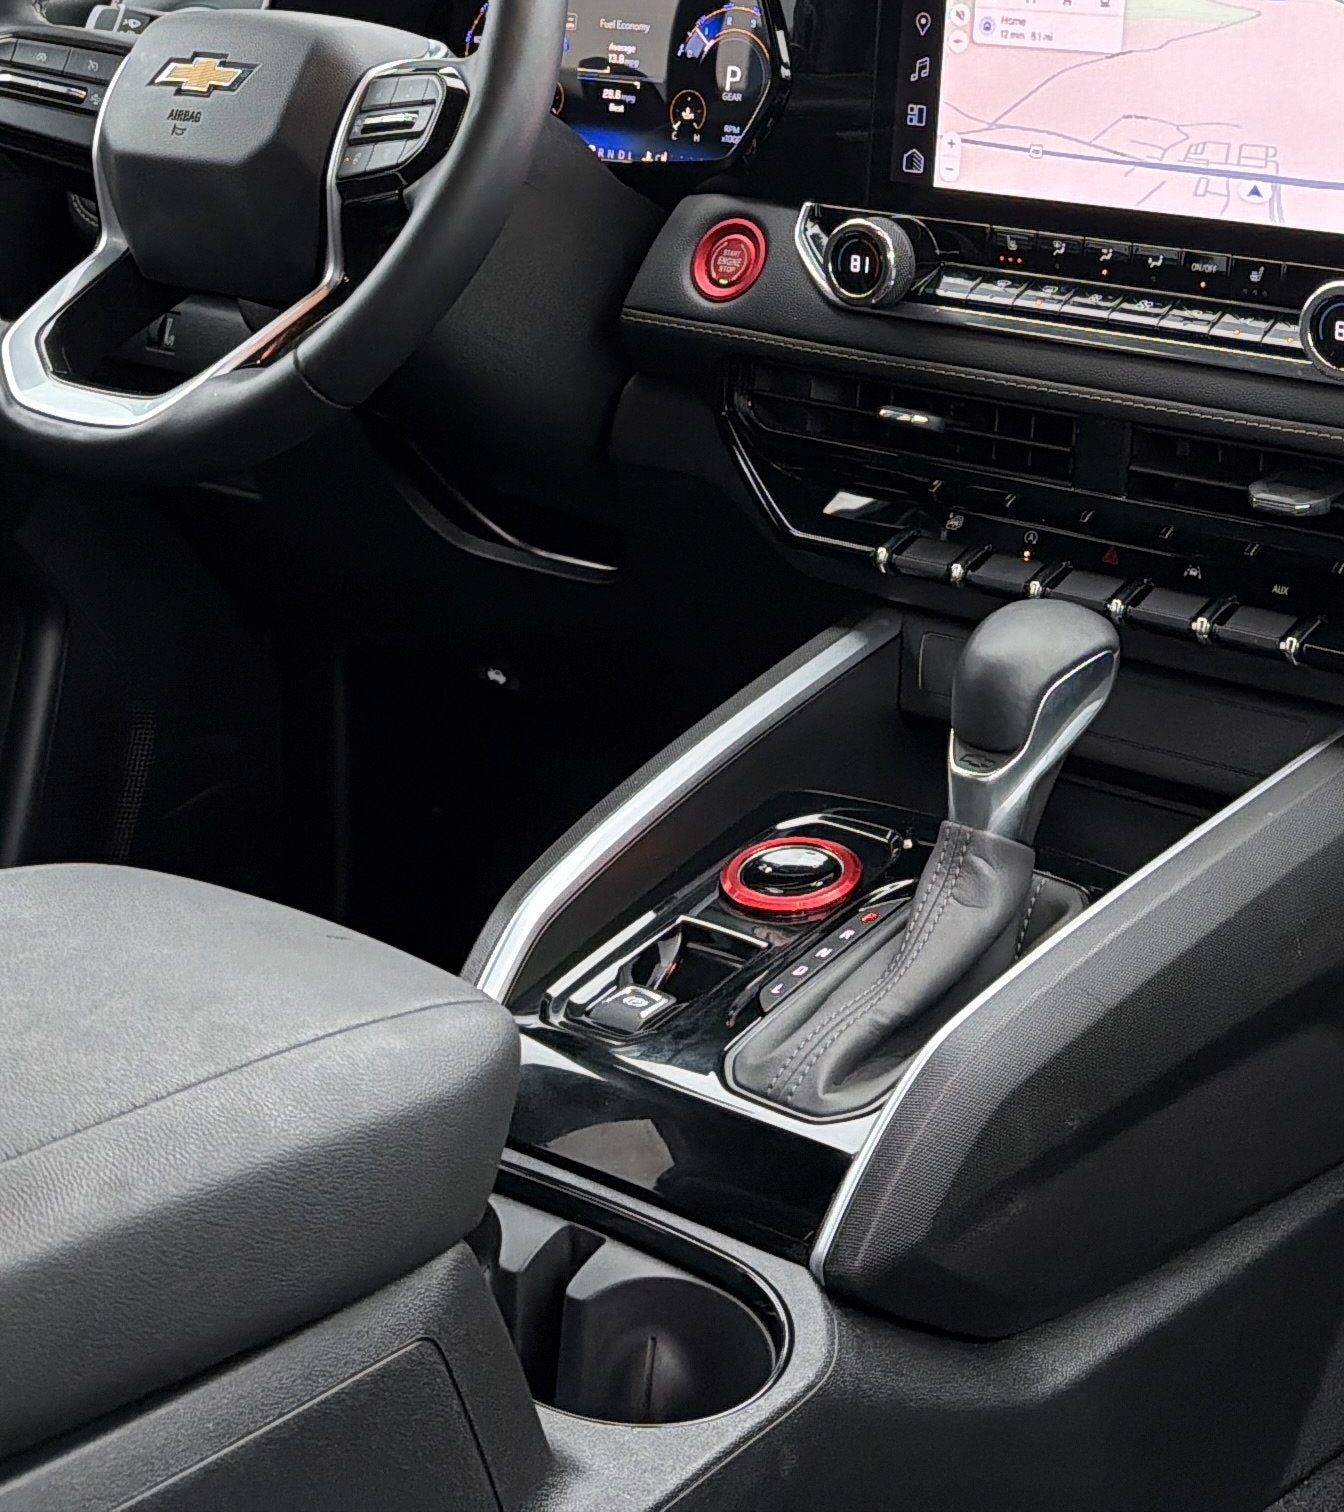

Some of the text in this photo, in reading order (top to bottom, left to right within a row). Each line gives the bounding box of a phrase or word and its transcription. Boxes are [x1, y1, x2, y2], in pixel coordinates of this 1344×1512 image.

[599, 18, 651, 34] Fuel Economy
[724, 65, 742, 92] P
[721, 92, 743, 102] GEAR
[850, 254, 870, 274] 81
[1191, 262, 1217, 274] ON/OFF
